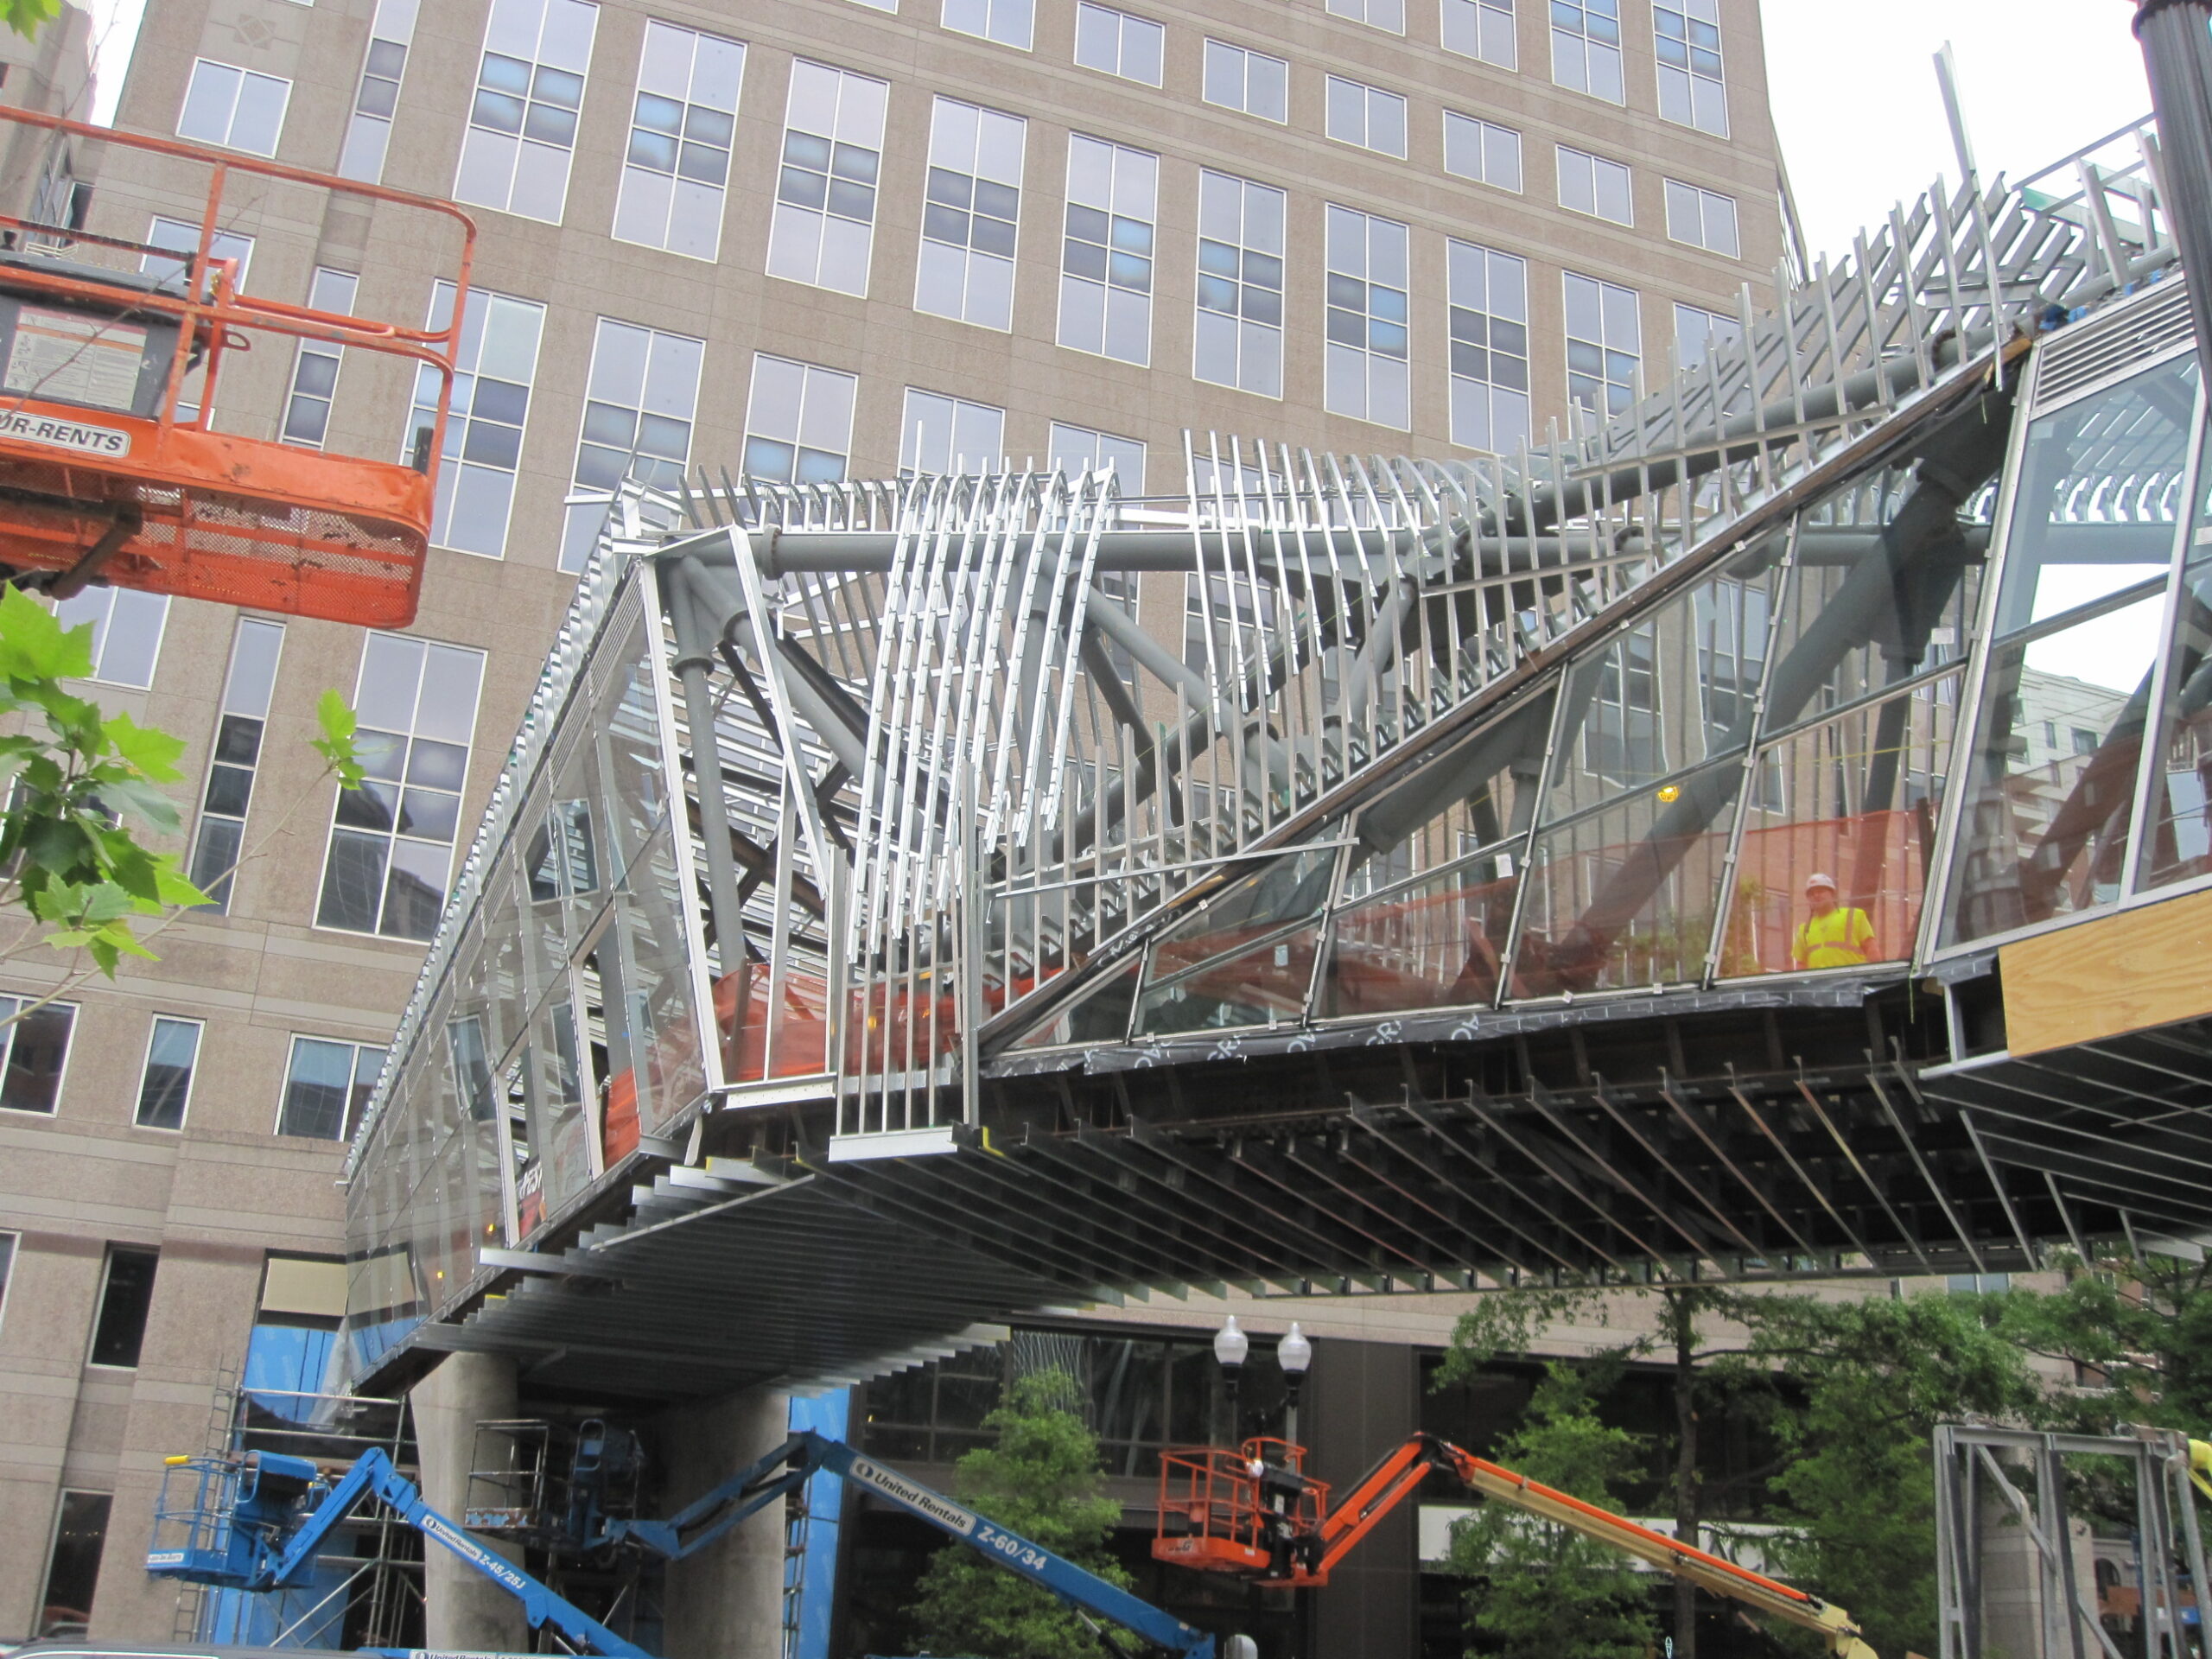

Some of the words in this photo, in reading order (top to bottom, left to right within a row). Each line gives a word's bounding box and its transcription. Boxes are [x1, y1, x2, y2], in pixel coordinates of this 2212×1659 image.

[874, 1472, 919, 1503] United
[918, 1496, 967, 1529] Rentals
[435, 1522, 457, 1542] United
[455, 1535, 478, 1557] Rentals
[977, 1526, 1047, 1571] Z-60/34
[479, 1554, 526, 1589] Z-45/25J
